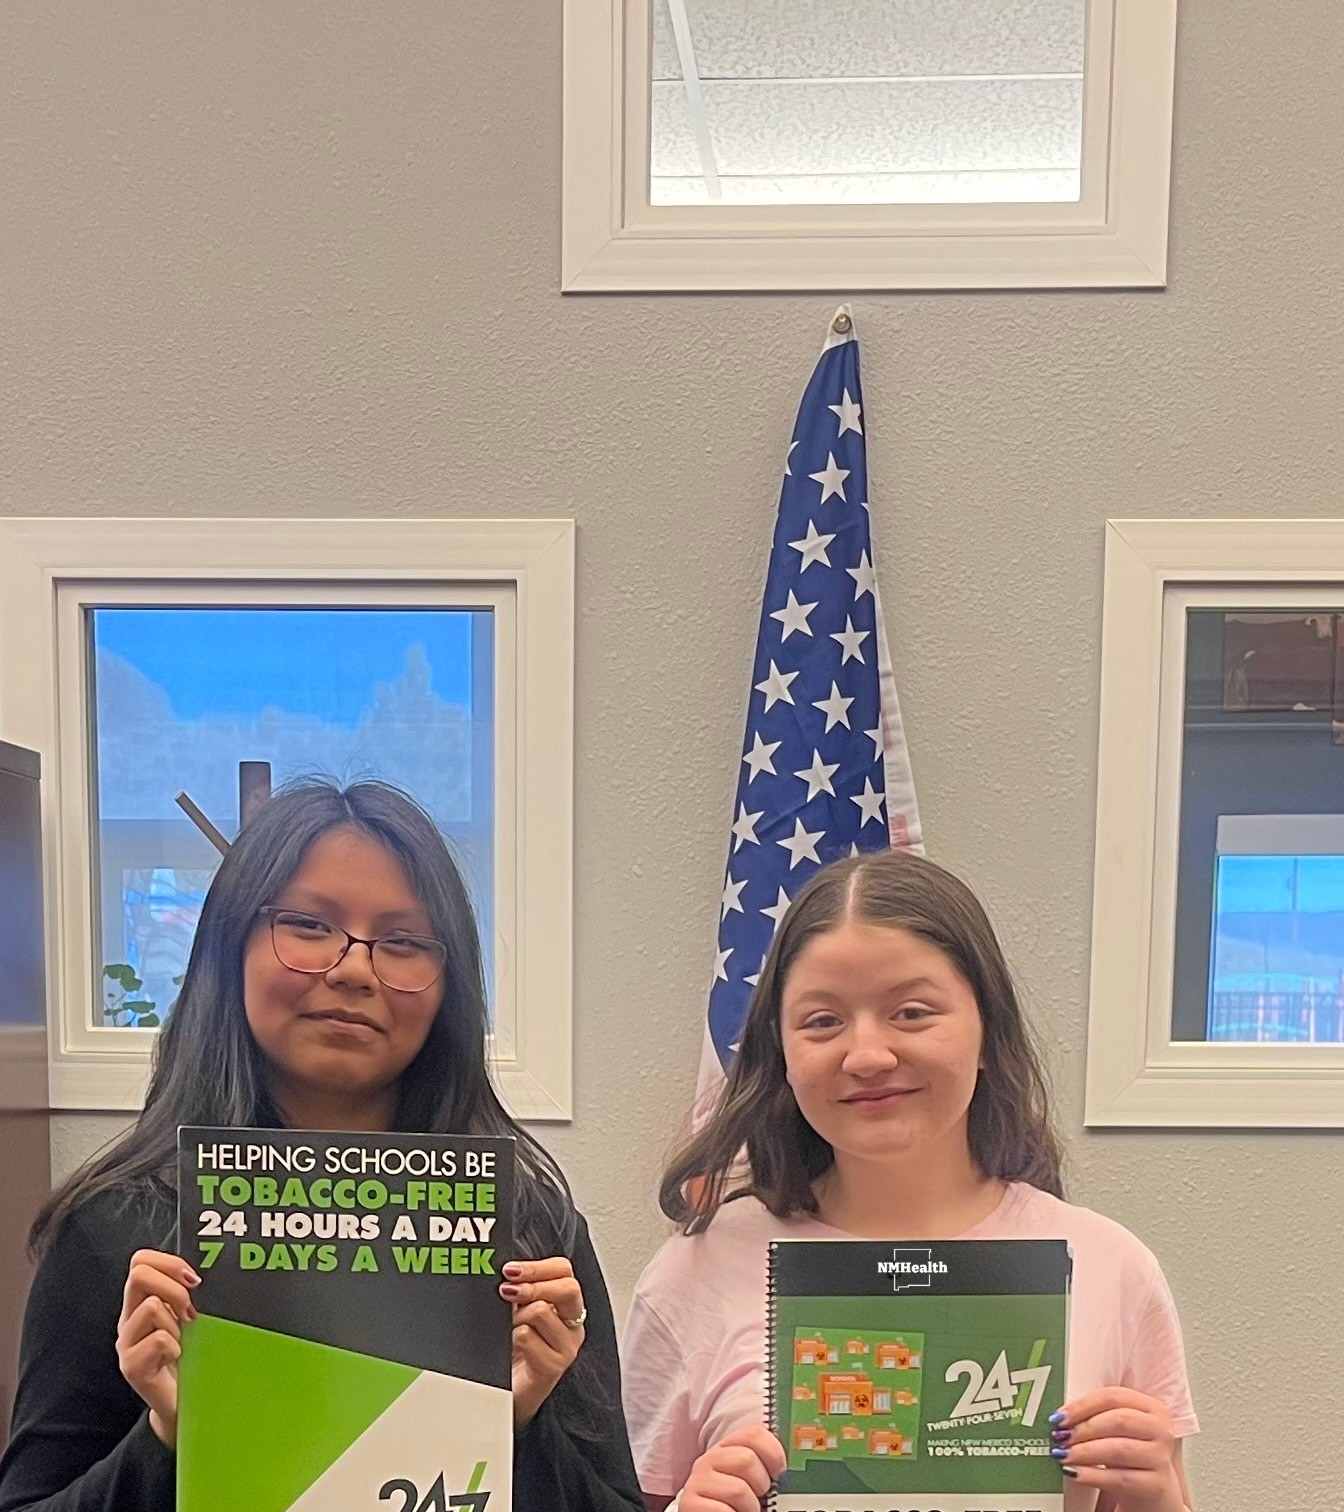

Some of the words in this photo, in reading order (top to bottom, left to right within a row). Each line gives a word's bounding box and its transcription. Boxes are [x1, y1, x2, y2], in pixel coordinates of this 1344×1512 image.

[197, 1143, 316, 1173] HELPING
[324, 1147, 457, 1177] SCHOOLS
[465, 1151, 496, 1178] BE
[197, 1175, 496, 1212] TOBACCO-FREE
[197, 1210, 248, 1236] 24
[261, 1212, 381, 1240] HOURS
[391, 1215, 417, 1240] A
[429, 1216, 496, 1242] DAY
[199, 1242, 225, 1268] 7
[240, 1242, 338, 1271] DAYS
[351, 1245, 379, 1272] A
[391, 1246, 496, 1275] WEEK
[877, 1261, 948, 1274] NMHealth
[927, 1418, 965, 1431] TWENTY
[927, 1439, 959, 1447] MAKING
[961, 1439, 981, 1447] NEW
[982, 1439, 1011, 1447] MEXICO
[928, 1447, 964, 1456] 100%
[967, 1447, 1051, 1456] TOBACCO-FREE
